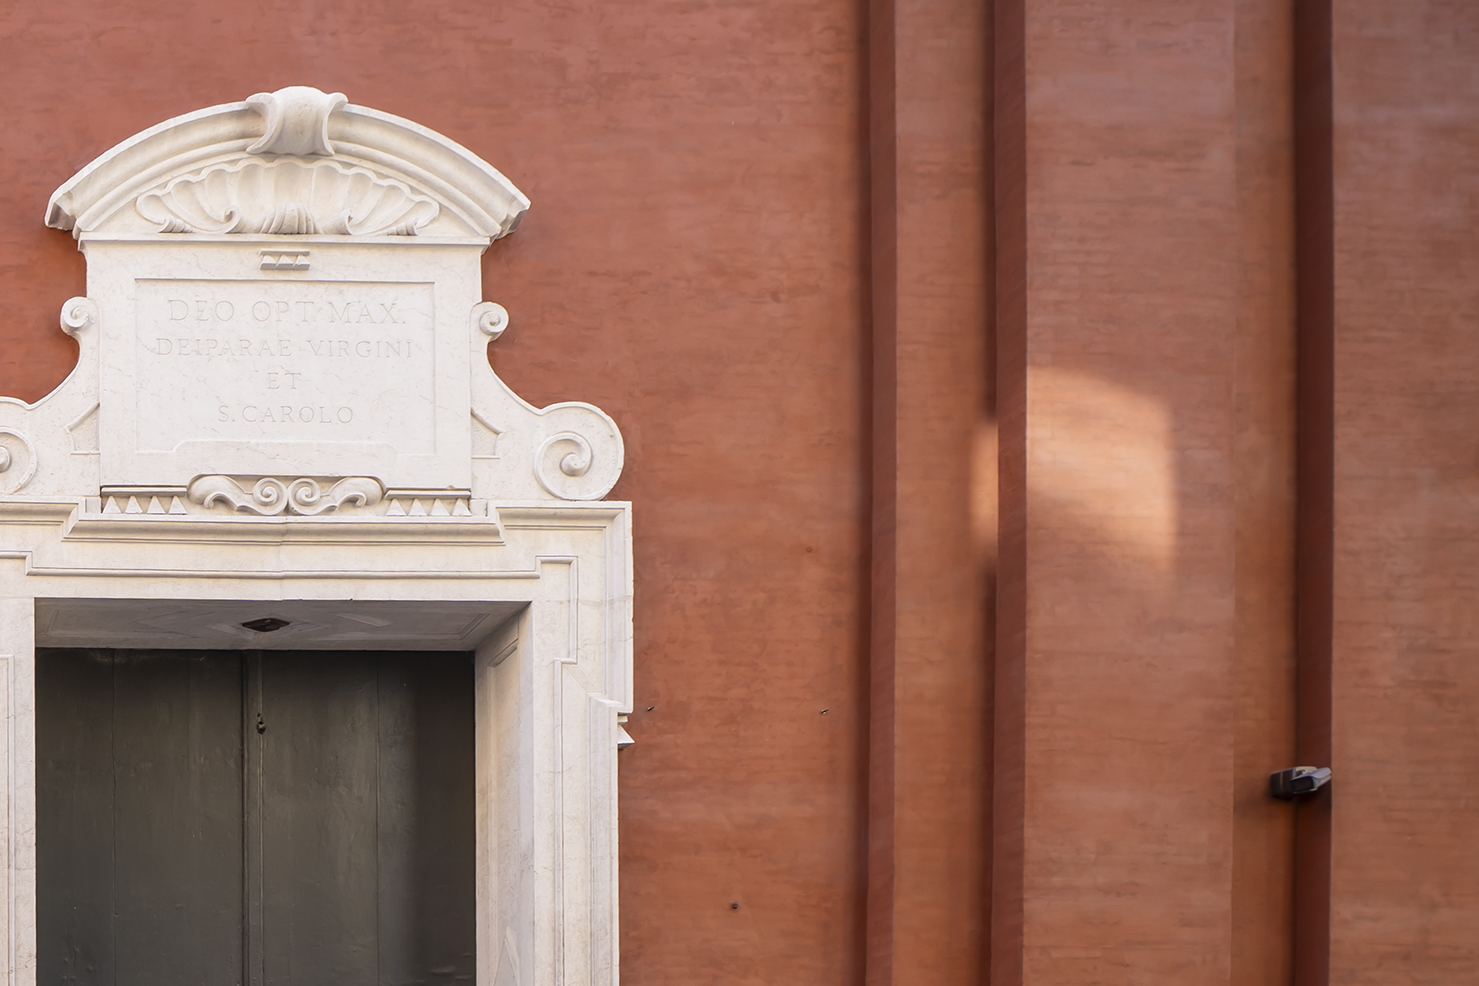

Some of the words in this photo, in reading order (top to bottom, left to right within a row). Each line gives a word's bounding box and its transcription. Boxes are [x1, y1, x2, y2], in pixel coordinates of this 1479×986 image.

[168, 299, 235, 322] DEO
[155, 337, 292, 357] DEIPARAE
[306, 339, 413, 358] VIRGINI
[267, 372, 302, 390] ET
